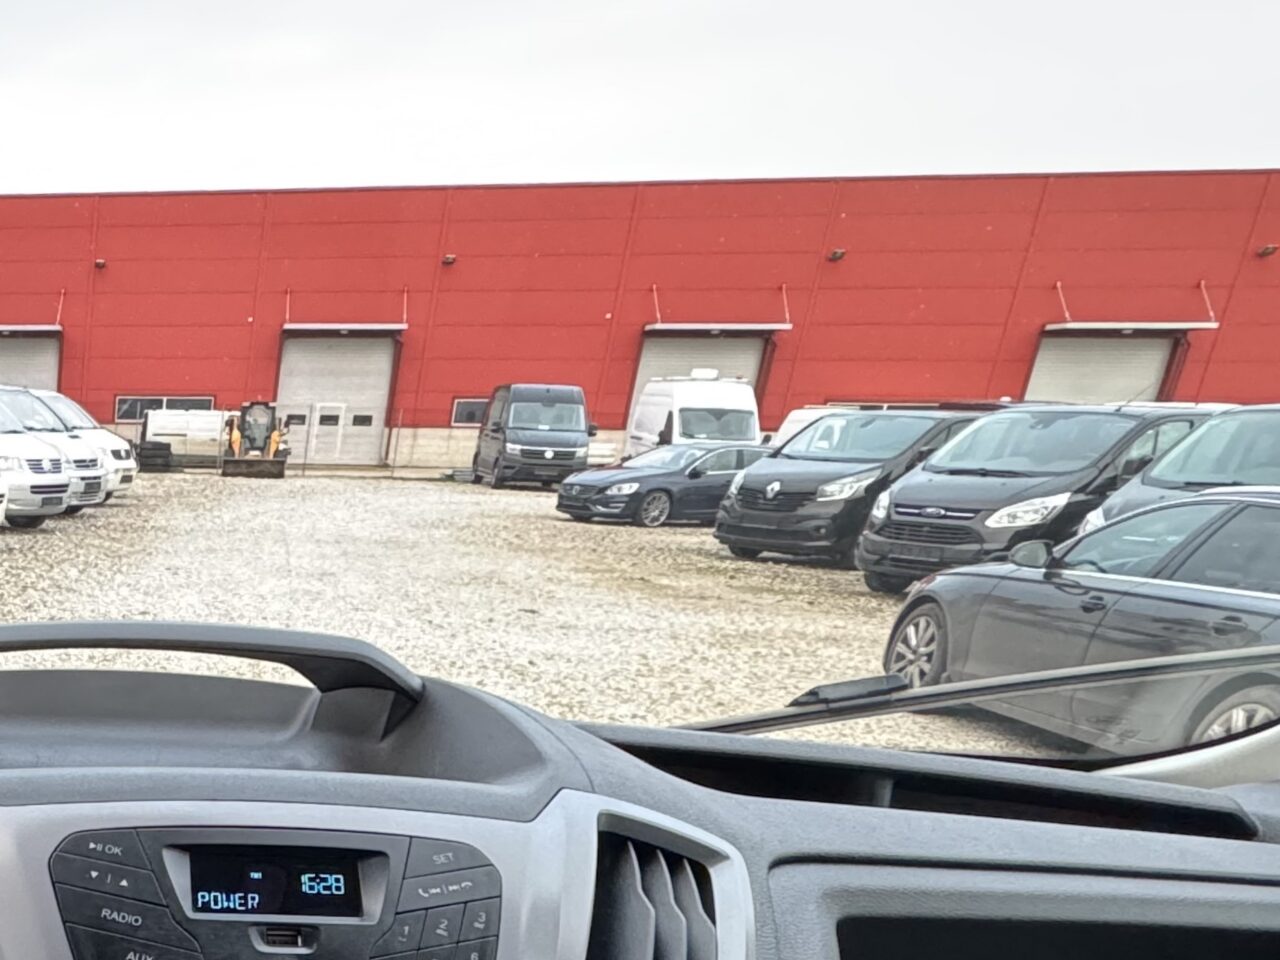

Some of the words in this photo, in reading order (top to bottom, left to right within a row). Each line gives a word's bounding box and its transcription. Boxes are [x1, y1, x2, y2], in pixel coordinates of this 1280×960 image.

[105, 844, 122, 855] OK
[433, 852, 454, 864] SET
[300, 873, 345, 895] 16:28
[197, 892, 259, 910] POWER
[101, 908, 142, 926] RADIO
